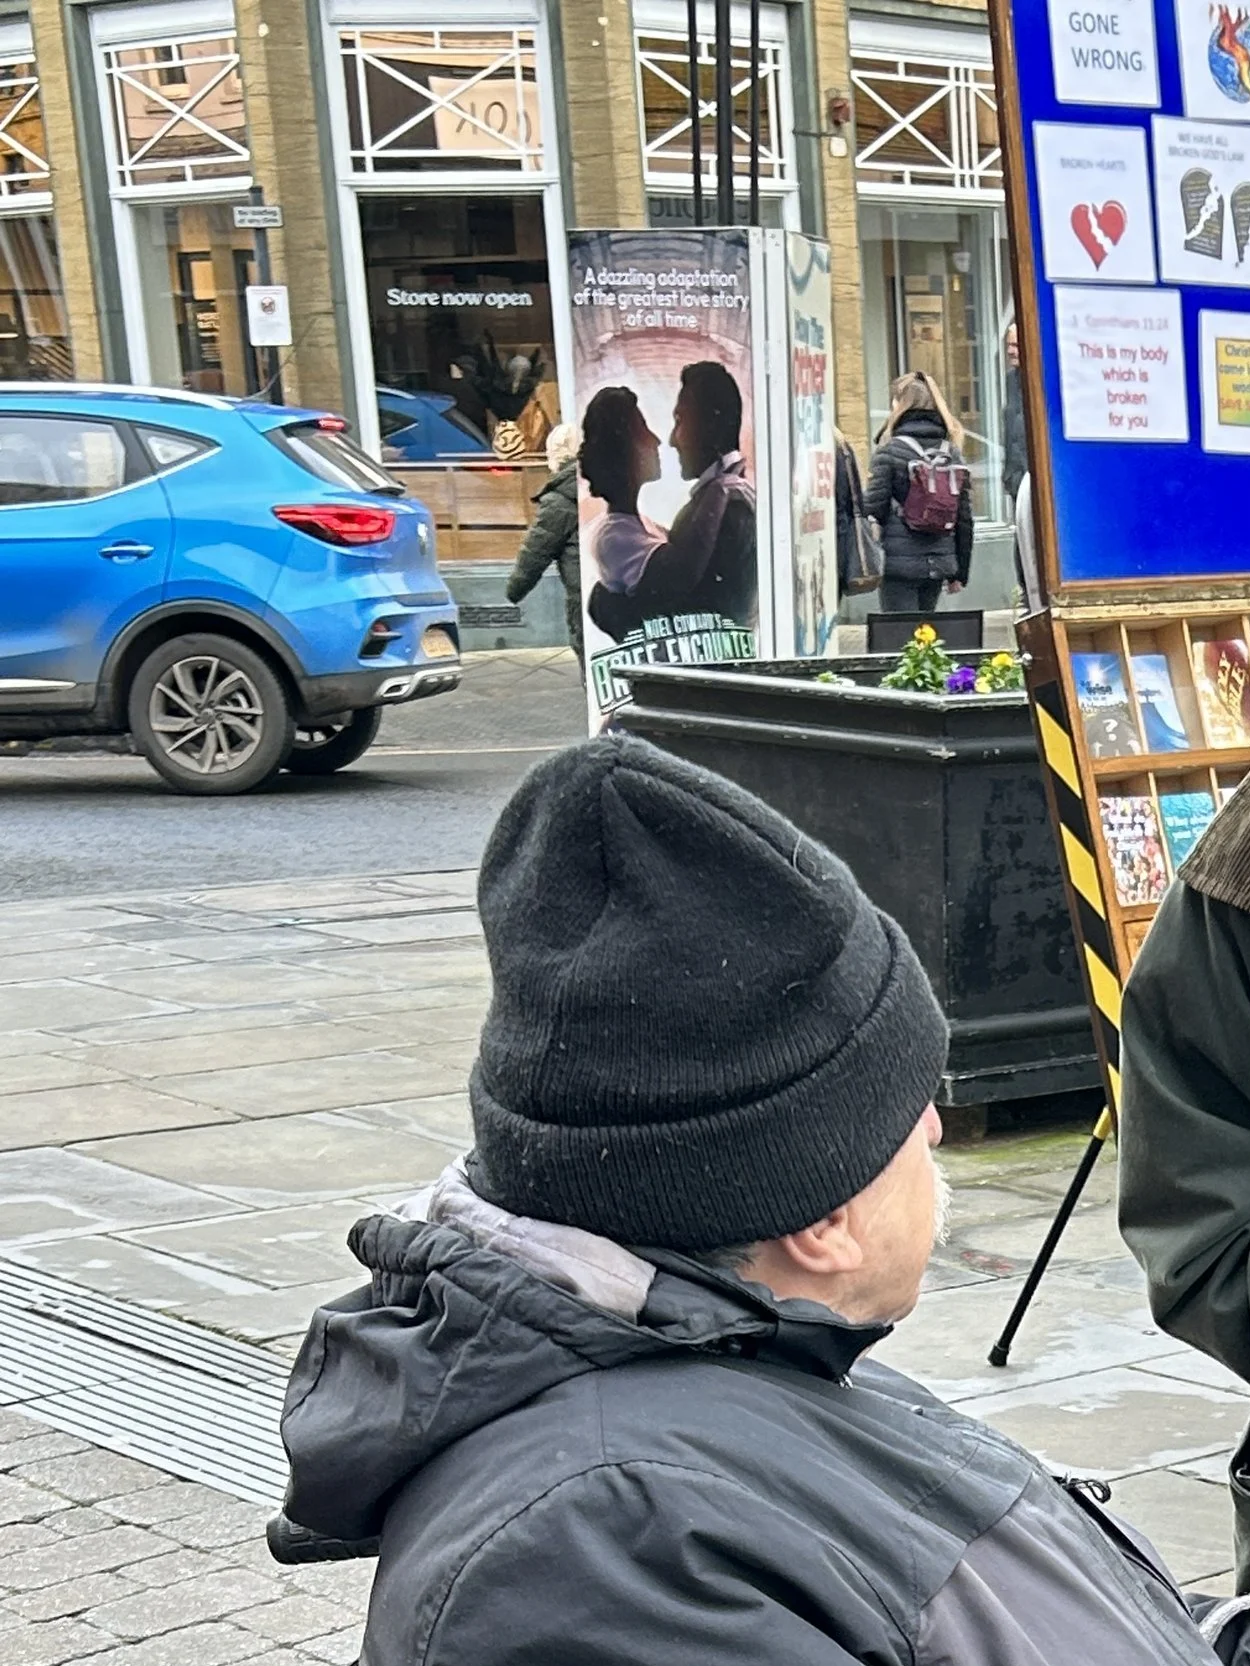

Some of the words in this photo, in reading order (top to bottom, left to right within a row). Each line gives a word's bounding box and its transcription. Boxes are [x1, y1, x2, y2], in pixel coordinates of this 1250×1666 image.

[1069, 12, 1120, 35] GONE
[1071, 47, 1143, 71] WRONG
[583, 267, 597, 285] A
[597, 267, 656, 289] dazzling
[657, 268, 738, 289] adaptation
[386, 288, 440, 306] Store
[442, 292, 485, 306] now
[485, 291, 533, 309] open
[574, 288, 591, 305] of
[592, 288, 617, 306] the
[618, 291, 679, 310] greatest
[680, 291, 710, 307] love
[711, 291, 750, 312] story
[627, 310, 644, 325] of
[644, 311, 662, 327] all
[664, 311, 698, 328] time
[1078, 343, 1104, 359] This
[1107, 344, 1117, 359] is
[1120, 348, 1137, 364] my
[1140, 345, 1169, 365] body
[1102, 367, 1136, 382] which
[1139, 367, 1148, 383] is
[1107, 389, 1147, 405] broken
[1108, 412, 1123, 426] for
[1128, 416, 1148, 430] you
